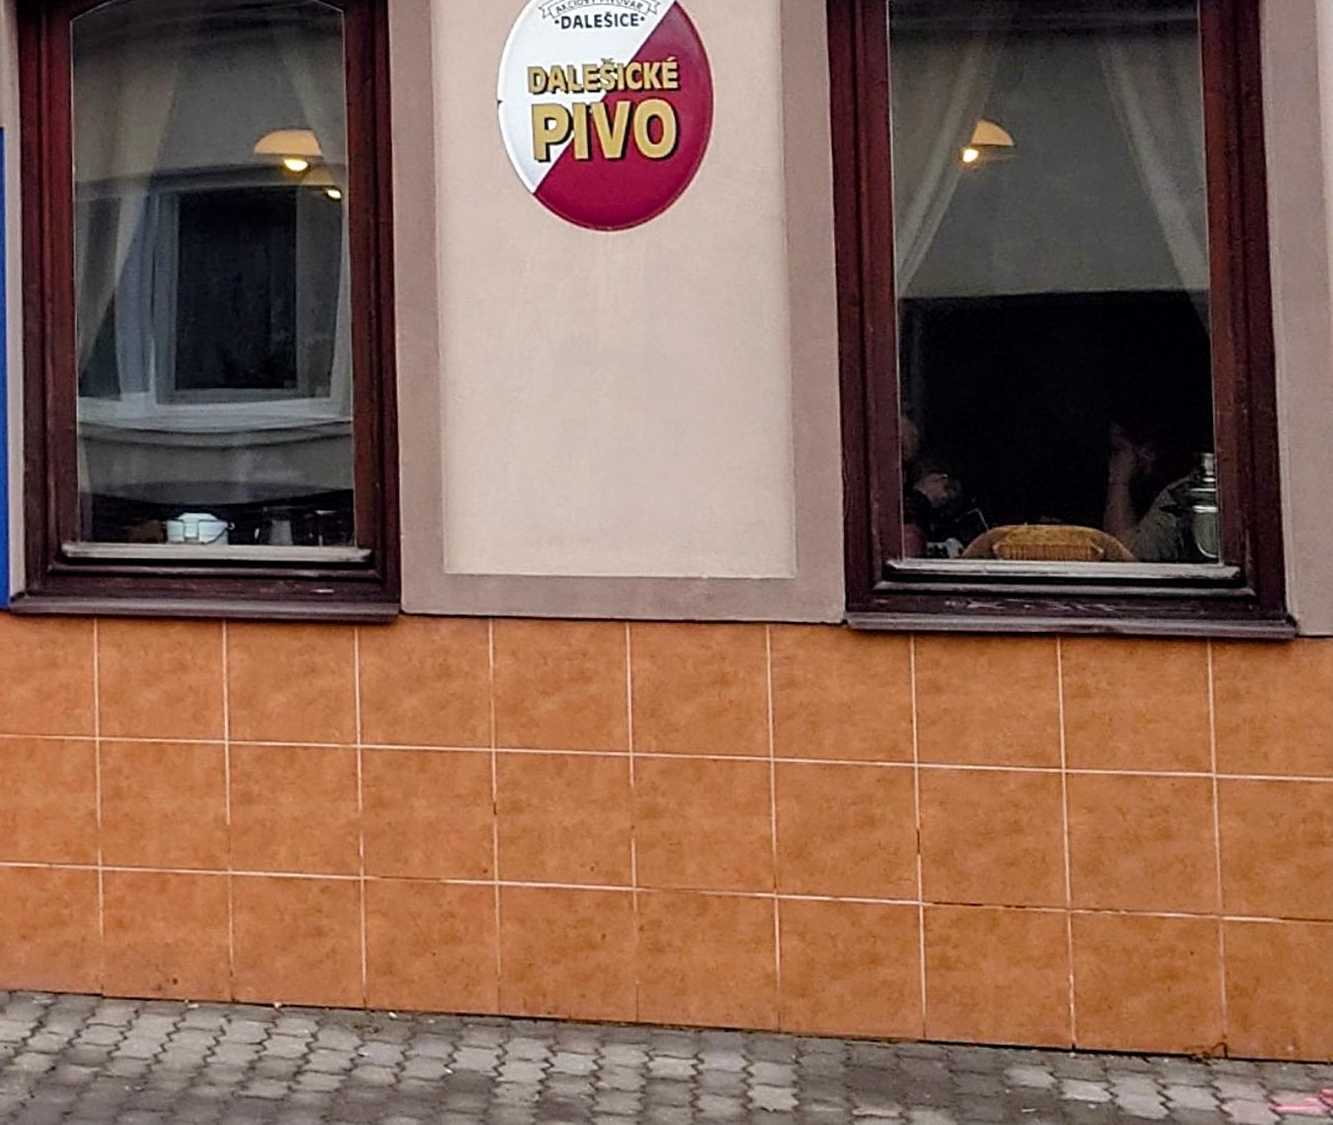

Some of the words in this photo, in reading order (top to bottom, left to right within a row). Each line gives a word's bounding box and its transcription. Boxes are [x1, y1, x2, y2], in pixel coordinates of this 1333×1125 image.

[561, 12, 639, 29] DALEŠICE
[527, 56, 680, 94] DALEŠICKÉ
[531, 98, 679, 162] PIVO
